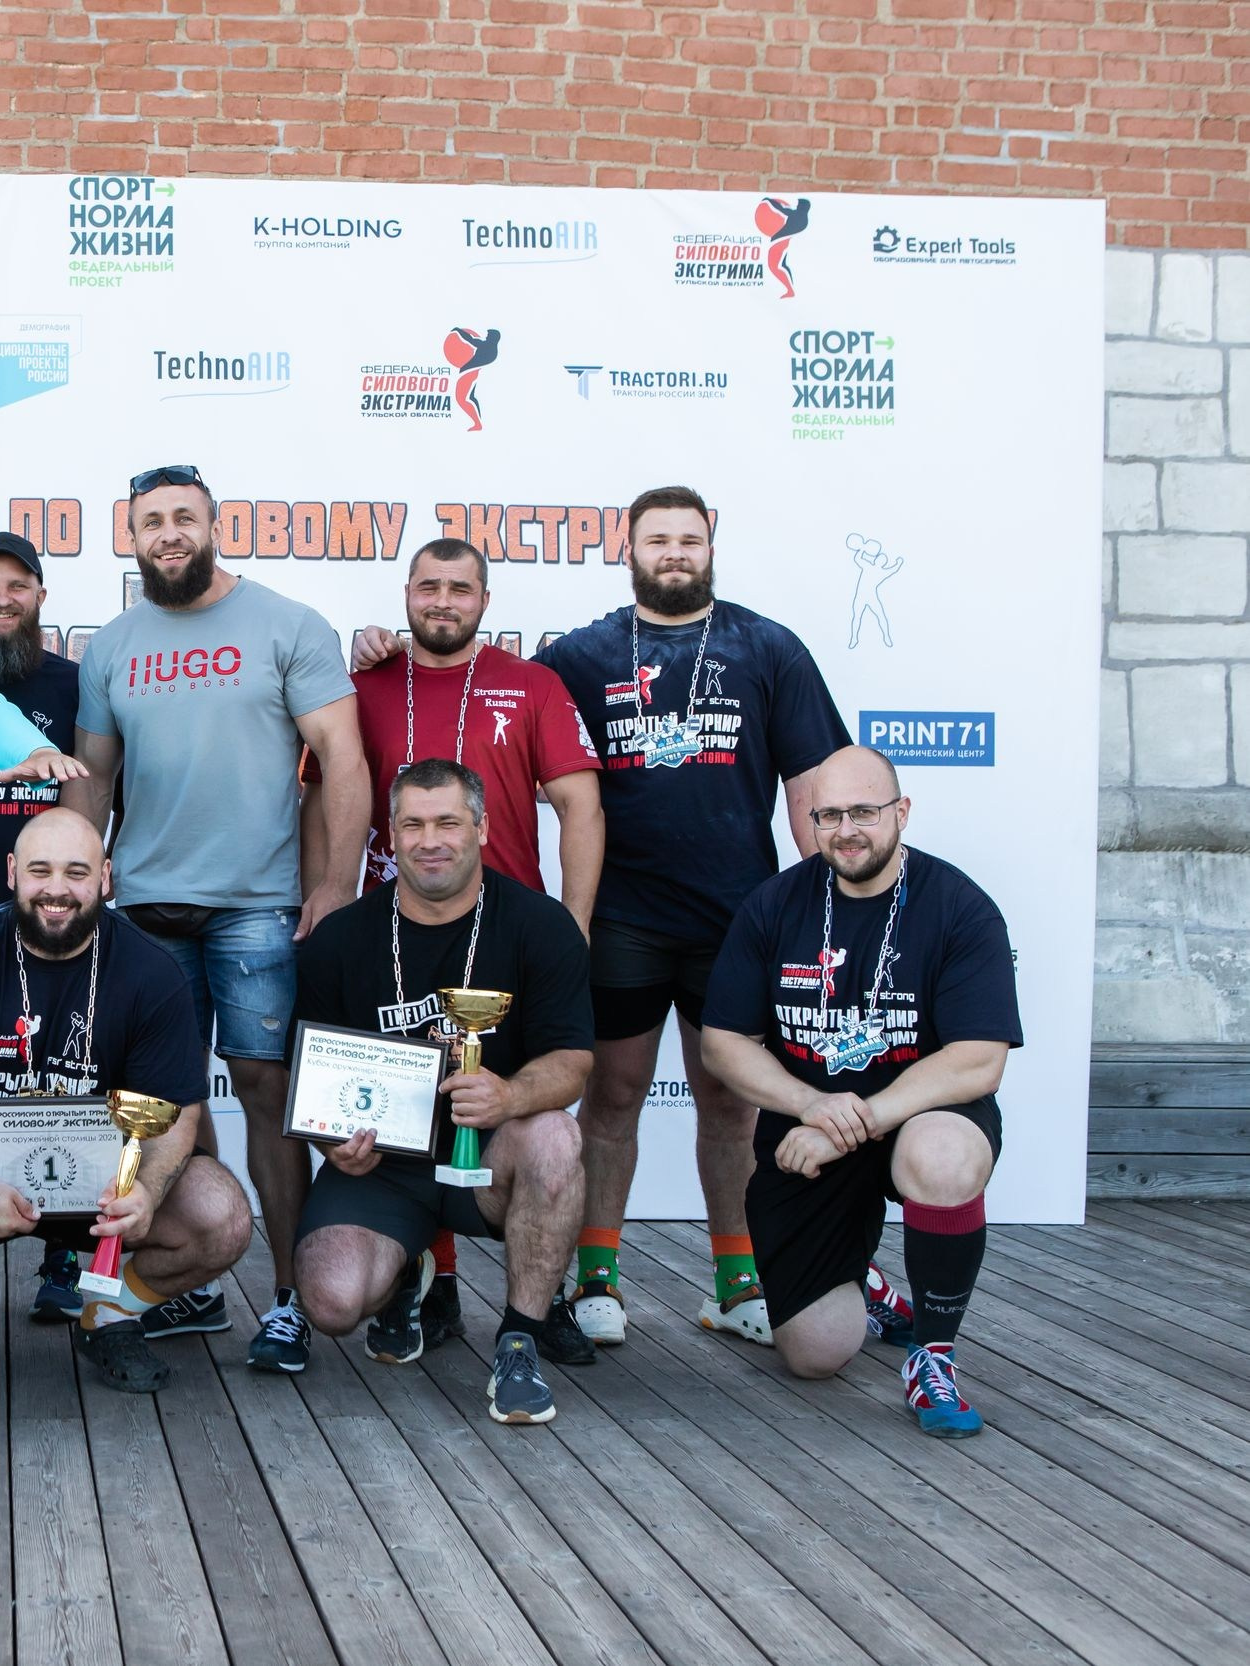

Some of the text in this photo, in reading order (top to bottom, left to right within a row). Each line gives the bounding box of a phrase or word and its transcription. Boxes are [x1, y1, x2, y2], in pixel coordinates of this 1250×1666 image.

[69, 177, 155, 201] СПОРТ
[69, 204, 174, 229] НОРМА
[254, 217, 402, 238] K-HOLDING
[462, 219, 598, 249] TechnoAIR
[69, 231, 174, 256] ЖИЗНИ
[254, 240, 351, 249] группа компаний
[673, 234, 762, 244] ФЕДЕРАЦИЯ
[906, 237, 1016, 257] Expert Tools
[675, 245, 761, 261] СИЛОВОГО
[69, 259, 174, 273] ФЕДЕРАЛЬНЫЙ
[674, 262, 764, 280] ЭКСТРИМА
[69, 276, 123, 287] ПРОЕКТ
[20, 323, 70, 332] ДЕМОГРАФИЯ
[789, 330, 875, 354] СПОРТ
[19, 357, 67, 369] ПРОЕКТЫ
[154, 351, 291, 381] TechnoAIR
[360, 365, 451, 376] ФЕДЕРАЦИЯ
[791, 358, 894, 382] НОРМА
[27, 370, 67, 382] РОССИИ
[362, 375, 449, 393] СИЛОВОГО
[609, 371, 728, 388] TRACTORI.RU
[361, 394, 452, 411] ЭКСТРИМА
[792, 385, 894, 409] ЖИЗНИ
[791, 412, 895, 426] ФЕДЕРАЛЬНЫЙ
[792, 429, 845, 440] ПРОЕКТ
[9, 497, 83, 557] ПО
[129, 646, 242, 688] HUGO
[128, 678, 240, 699] HUGO BOSS
[473, 688, 526, 698] Strongman
[485, 699, 517, 709] Russia
[709, 697, 740, 708] strong
[870, 721, 986, 746] PRINT 71
[877, 748, 985, 758] ОЛИГРАФИЧЕСКИЙ ЦЕНТР
[780, 976, 821, 986] ЭКСТРИМА
[879, 991, 915, 1002] strong
[309, 1044, 433, 1069] ПО СИЛОВОМУ ЭКСТРИМУ
[65, 1060, 98, 1073] strong
[307, 1058, 432, 1083] Кубок оружейной столицы 2024
[355, 1087, 373, 1111] 3
[3, 1119, 60, 1129] СИЛОВОМУ
[13, 1134, 60, 1145] оружейной
[62, 1134, 97, 1143] столицы
[99, 1134, 117, 1142] 2024
[43, 1155, 59, 1182] 1
